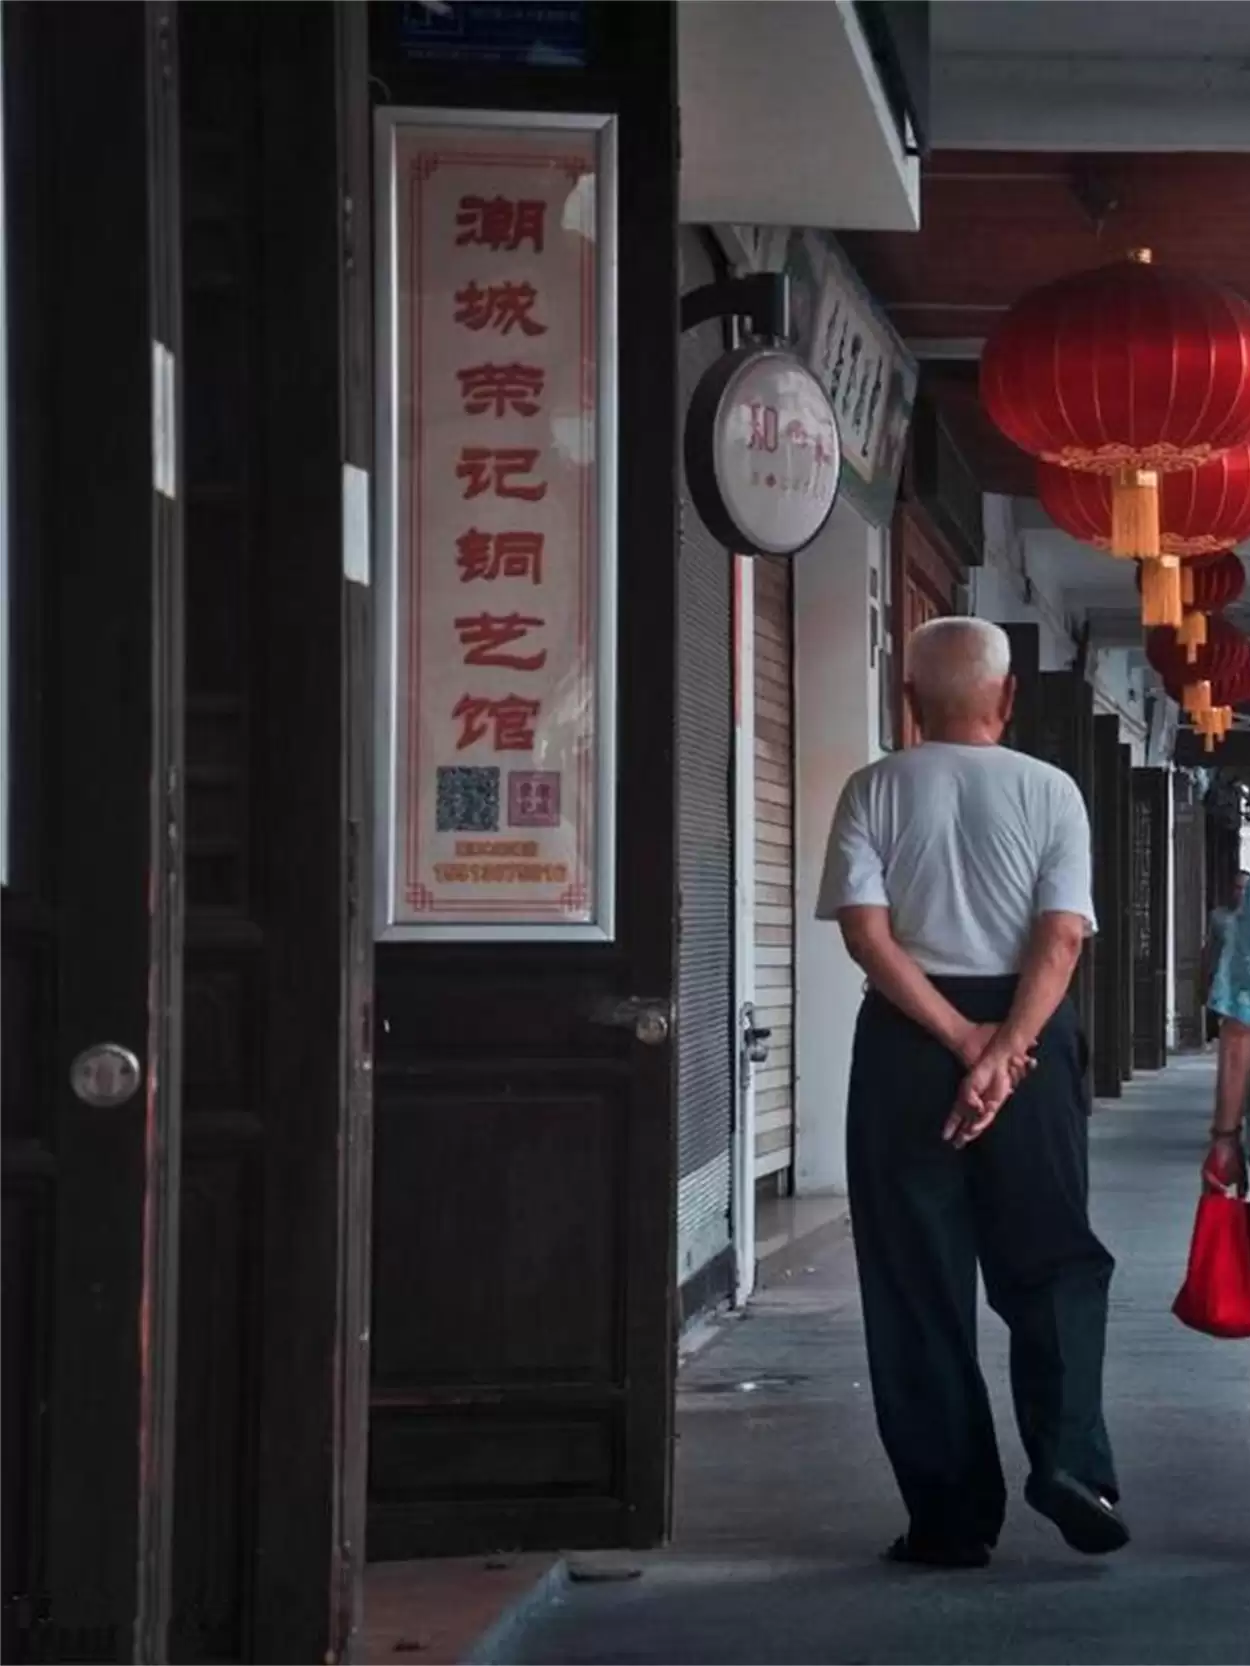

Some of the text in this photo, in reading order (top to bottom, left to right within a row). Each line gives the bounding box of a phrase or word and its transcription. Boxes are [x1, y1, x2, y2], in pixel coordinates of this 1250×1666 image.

[453, 193, 549, 751] 潮城荣记铜艺馆
